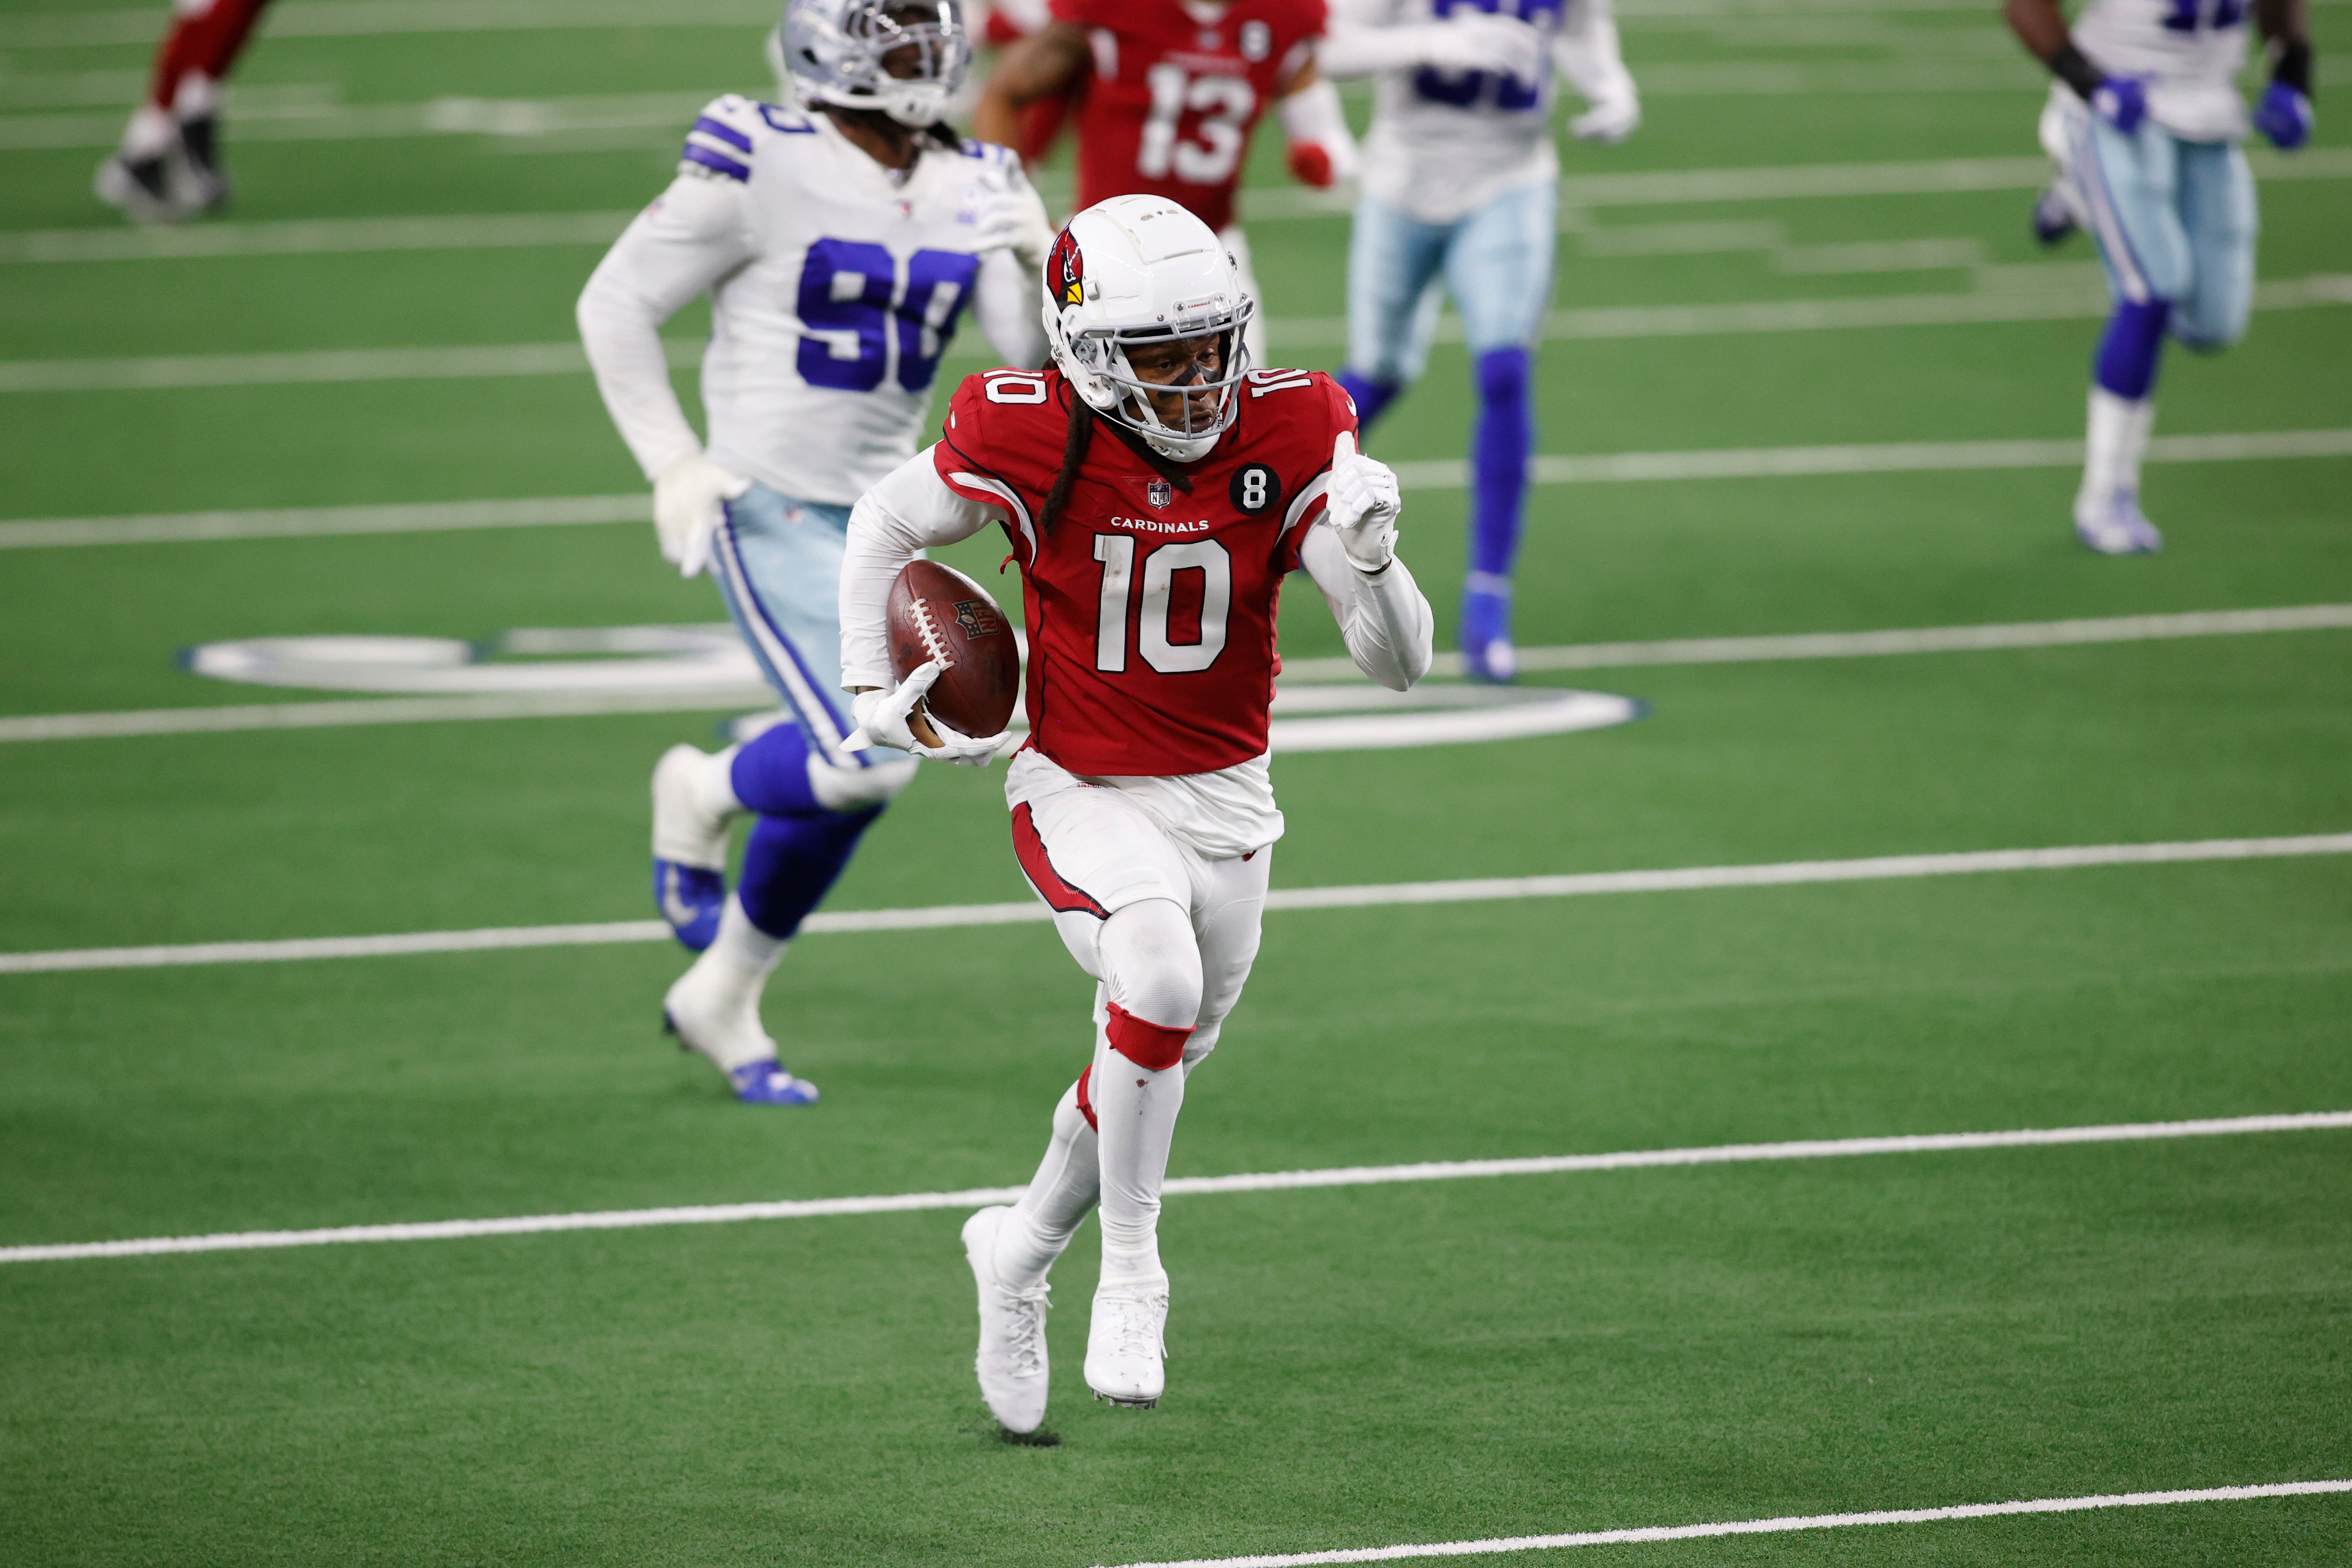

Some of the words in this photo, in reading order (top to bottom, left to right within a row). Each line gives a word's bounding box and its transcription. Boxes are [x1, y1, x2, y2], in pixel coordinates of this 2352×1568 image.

[1138, 61, 1256, 184] 13
[796, 236, 980, 392] 90
[982, 369, 1048, 405] 10
[1246, 368, 1313, 399] 10
[1243, 469, 1267, 509] 8
[1111, 517, 1209, 533] CARDINALS
[1093, 532, 1233, 674] 10
